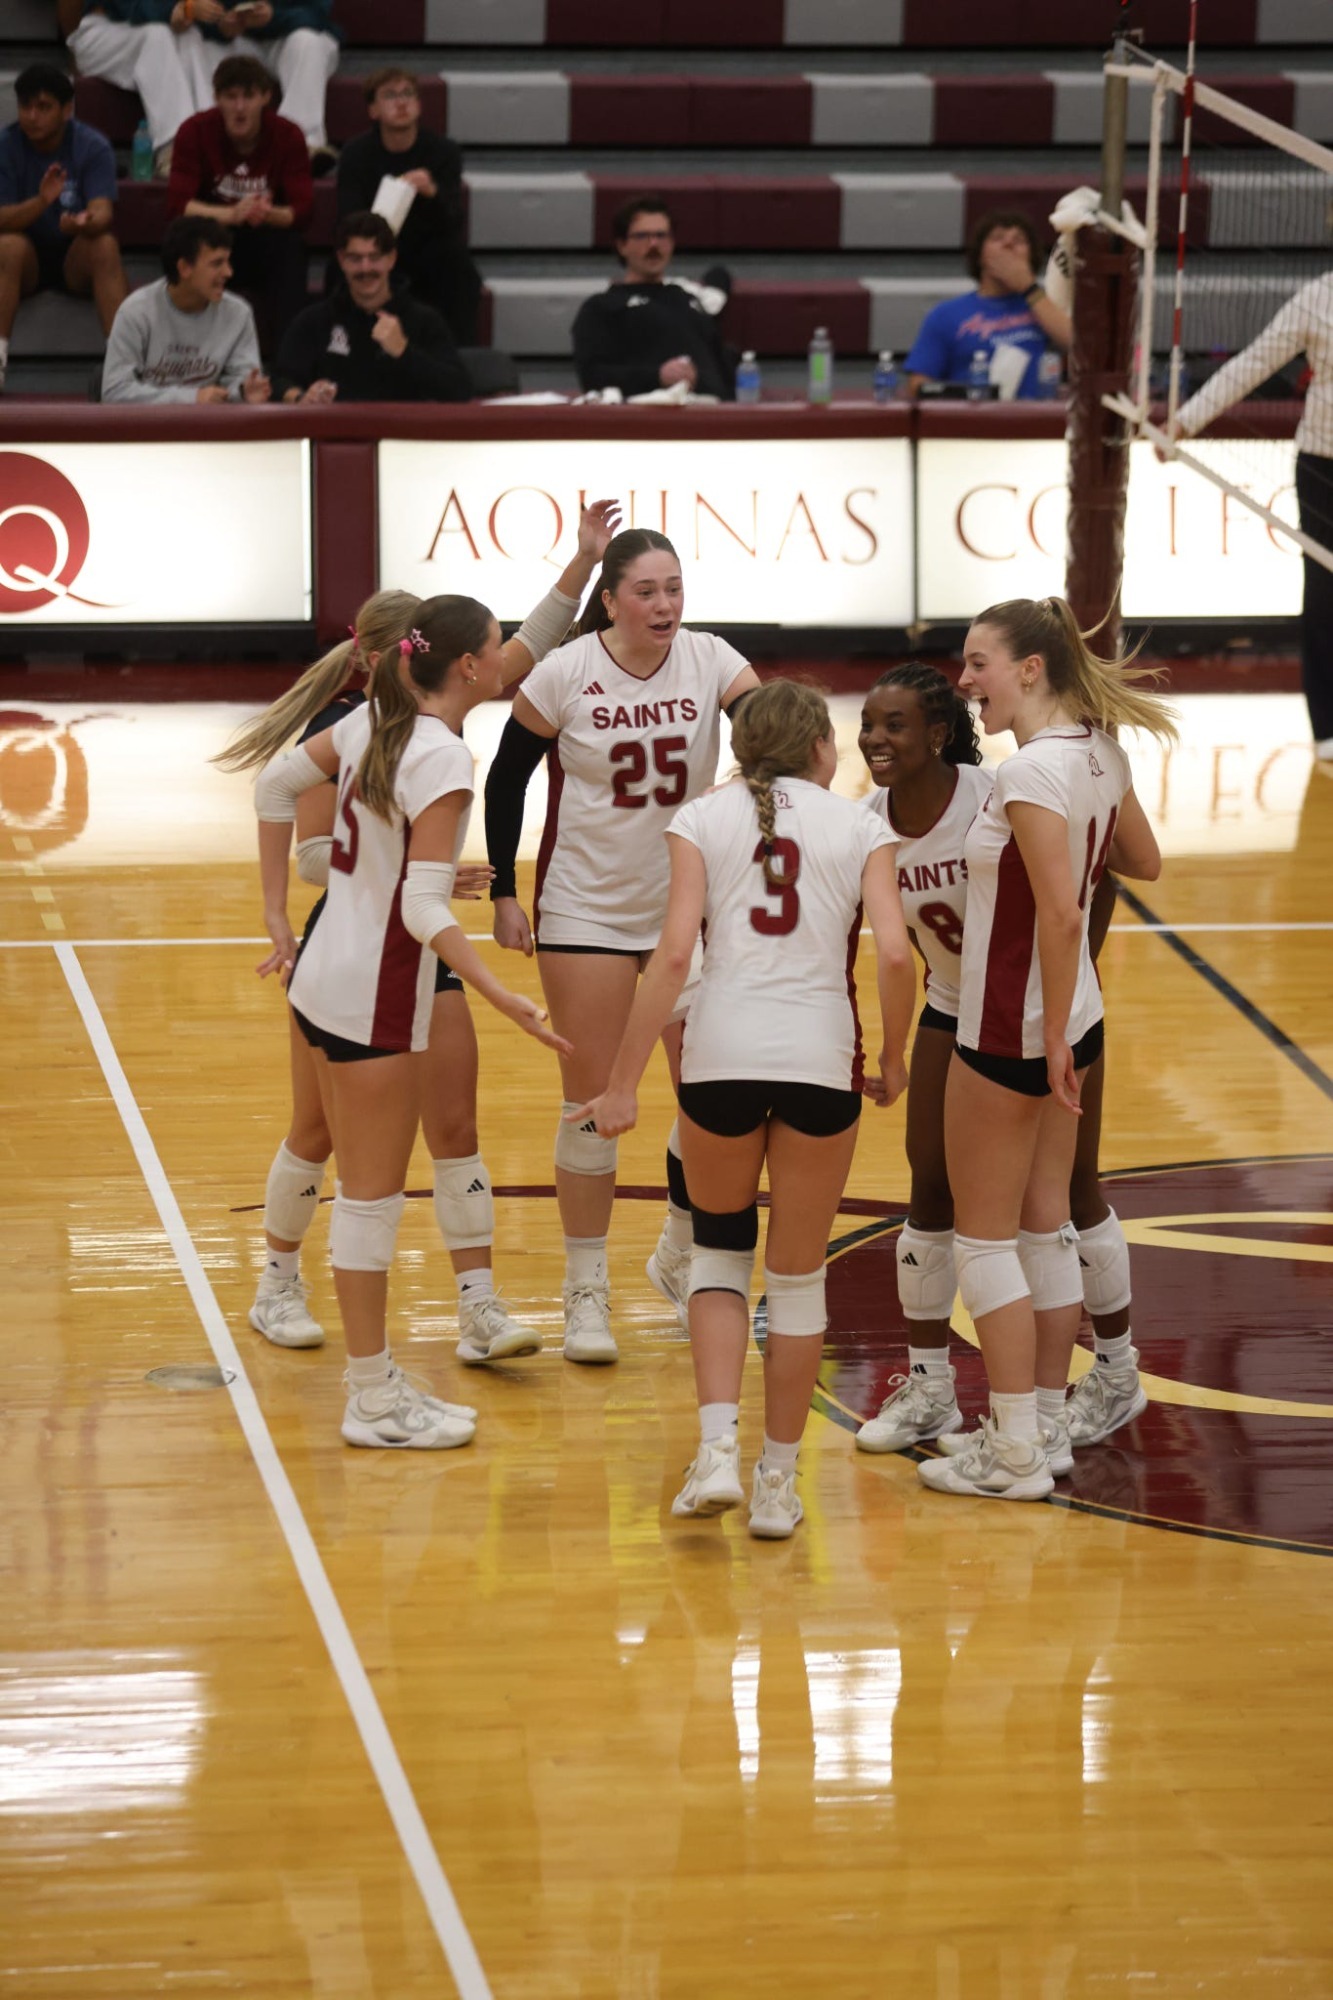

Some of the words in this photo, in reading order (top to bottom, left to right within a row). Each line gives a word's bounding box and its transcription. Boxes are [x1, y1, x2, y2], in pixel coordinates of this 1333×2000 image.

[591, 698, 699, 731] SAINTS
[609, 735, 689, 809] 25
[749, 836, 800, 936] 3
[897, 857, 969, 893] AINTS
[918, 901, 964, 956] 8
